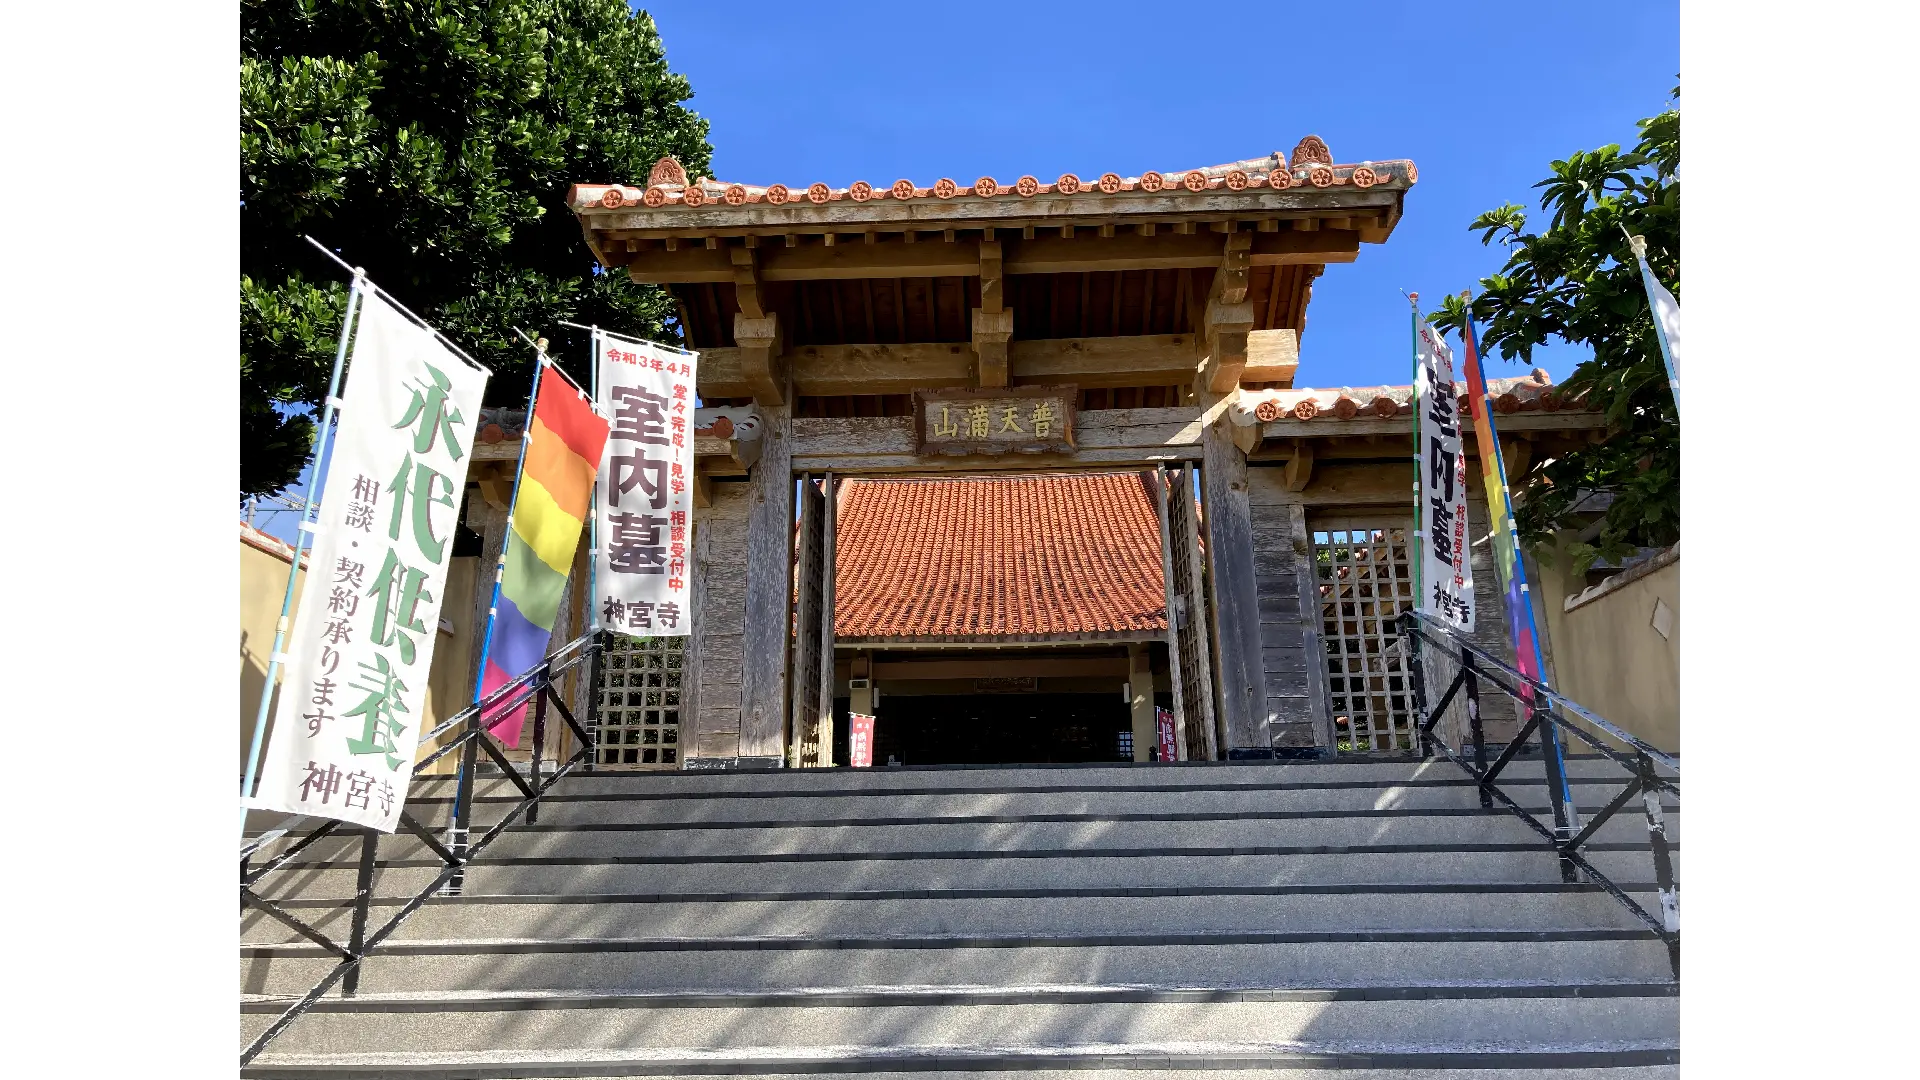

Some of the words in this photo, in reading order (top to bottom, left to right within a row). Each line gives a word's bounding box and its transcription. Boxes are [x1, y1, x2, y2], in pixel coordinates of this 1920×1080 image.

[606, 348, 690, 377] 令和3年4月
[608, 385, 671, 574] 室内墓
[302, 473, 380, 739] 相談・契約承ります
[340, 360, 464, 772] 永代供養
[603, 595, 681, 628] 神宮寺
[299, 760, 395, 817] 神宮寺
